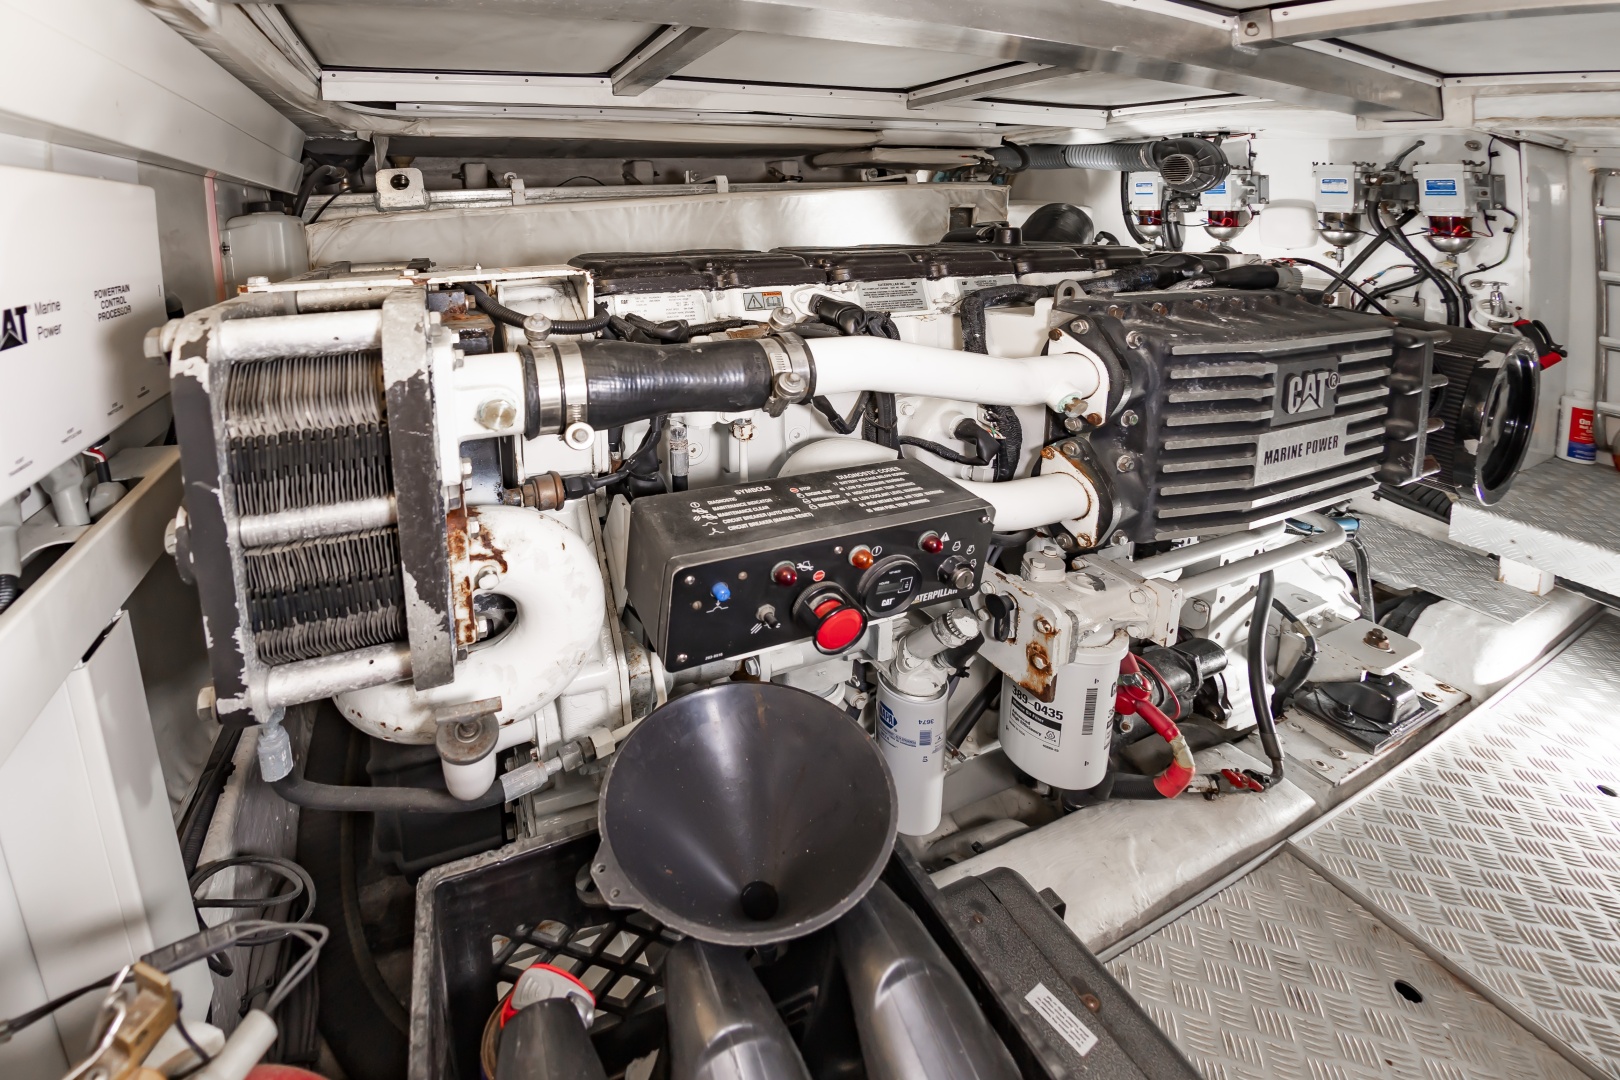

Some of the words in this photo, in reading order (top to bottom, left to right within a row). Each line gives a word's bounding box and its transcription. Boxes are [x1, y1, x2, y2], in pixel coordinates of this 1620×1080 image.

[94, 284, 130, 299] POWERTRAIN
[34, 300, 61, 316] Marine
[101, 296, 127, 310] CONTROL
[98, 305, 131, 322] PROCESSOR
[0, 305, 28, 352] AT
[37, 324, 62, 340] Power
[1264, 443, 1303, 466] MARINE
[1306, 435, 1339, 456] POWER
[836, 470, 878, 479] DIAGNOSTIC
[734, 486, 771, 494] SYMBOLS
[712, 502, 747, 511] MAINTENANCE
[717, 508, 753, 517] MAINTENANCE
[748, 519, 773, 527] BREAKER
[881, 598, 895, 607] CAT
[911, 588, 958, 604] ATERPILLAR
[1012, 685, 1063, 720] 389-0435
